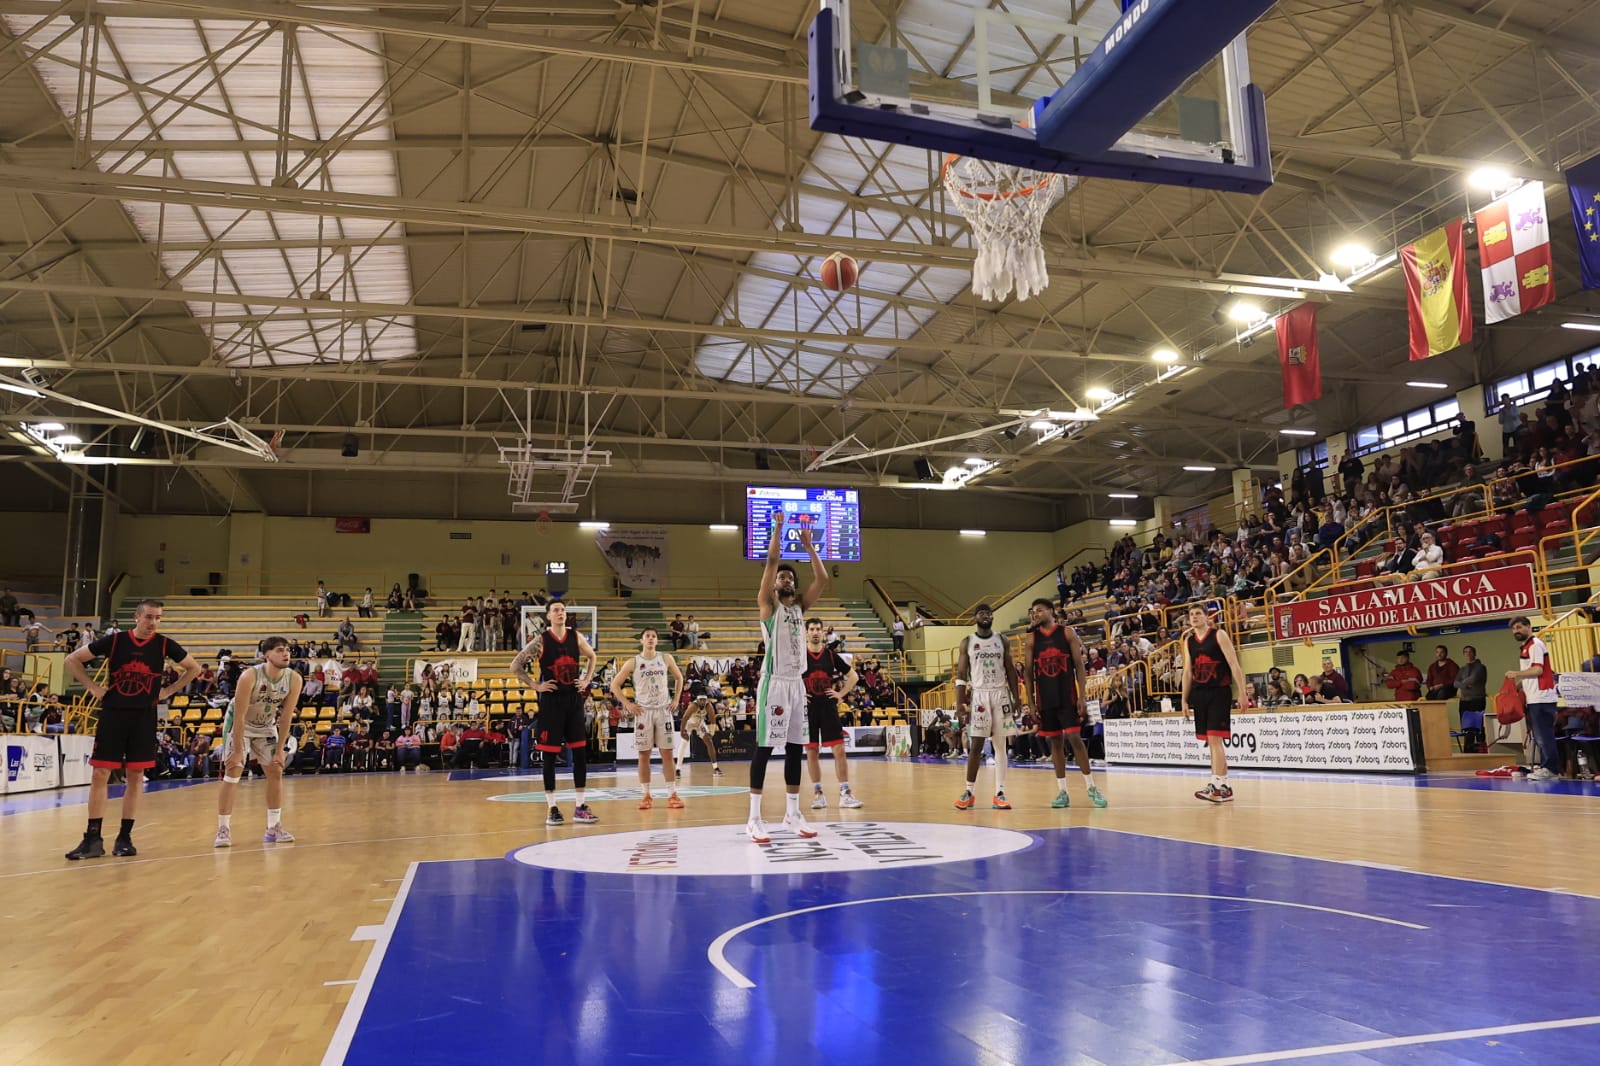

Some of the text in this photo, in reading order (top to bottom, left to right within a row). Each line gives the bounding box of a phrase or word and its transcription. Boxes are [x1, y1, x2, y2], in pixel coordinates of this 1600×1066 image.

[1104, 0, 1149, 55] MONDO
[1297, 591, 1528, 636] PATRIMONIO DE LA HUMANIDAD
[1318, 573, 1496, 617] SALAMANCA
